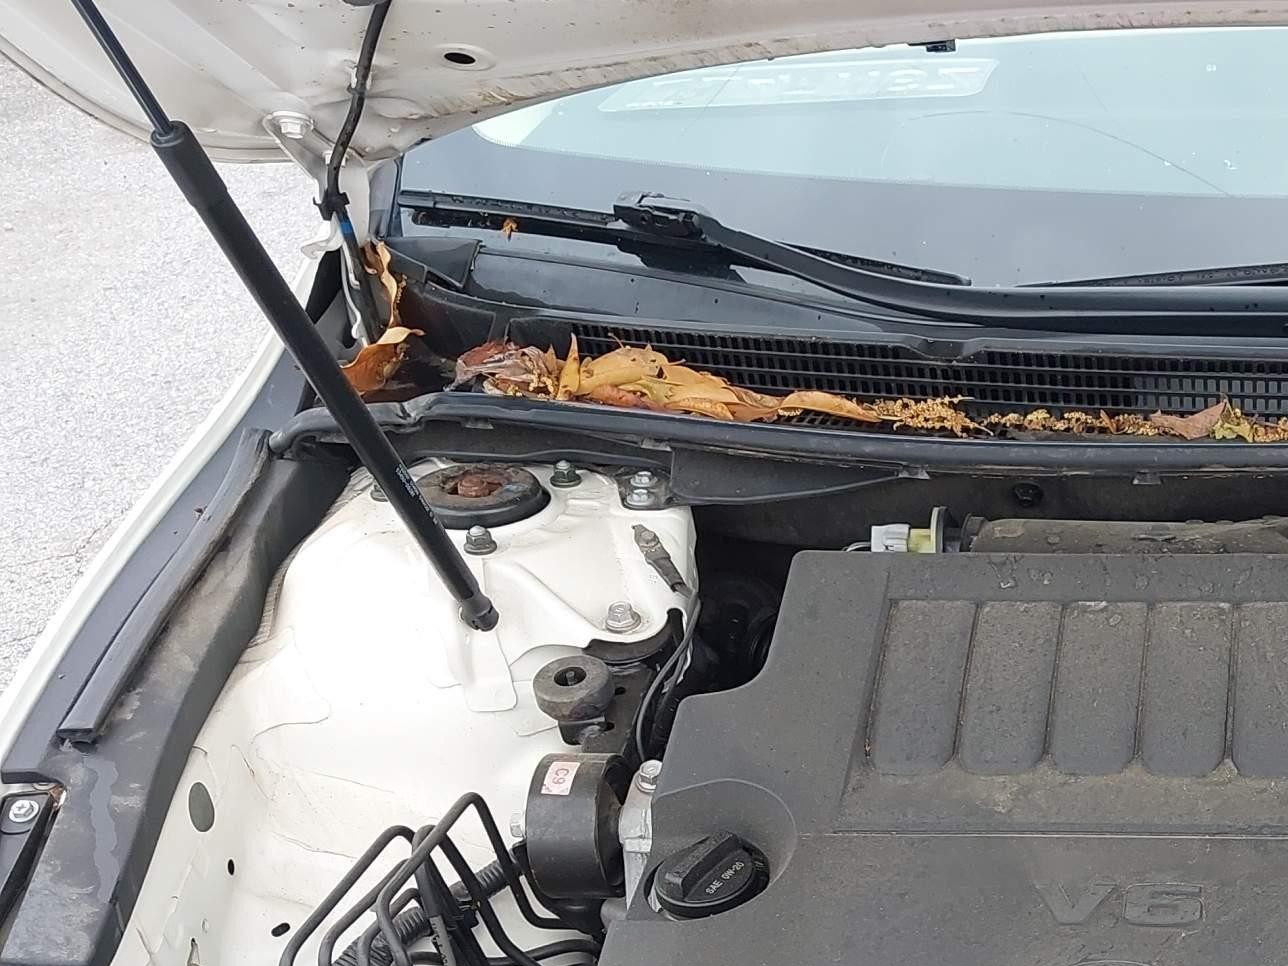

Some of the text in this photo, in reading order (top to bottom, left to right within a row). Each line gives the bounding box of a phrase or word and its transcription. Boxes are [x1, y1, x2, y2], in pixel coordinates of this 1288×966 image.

[705, 861, 745, 895] SAE 0W-20
[1033, 881, 1206, 928] V6
